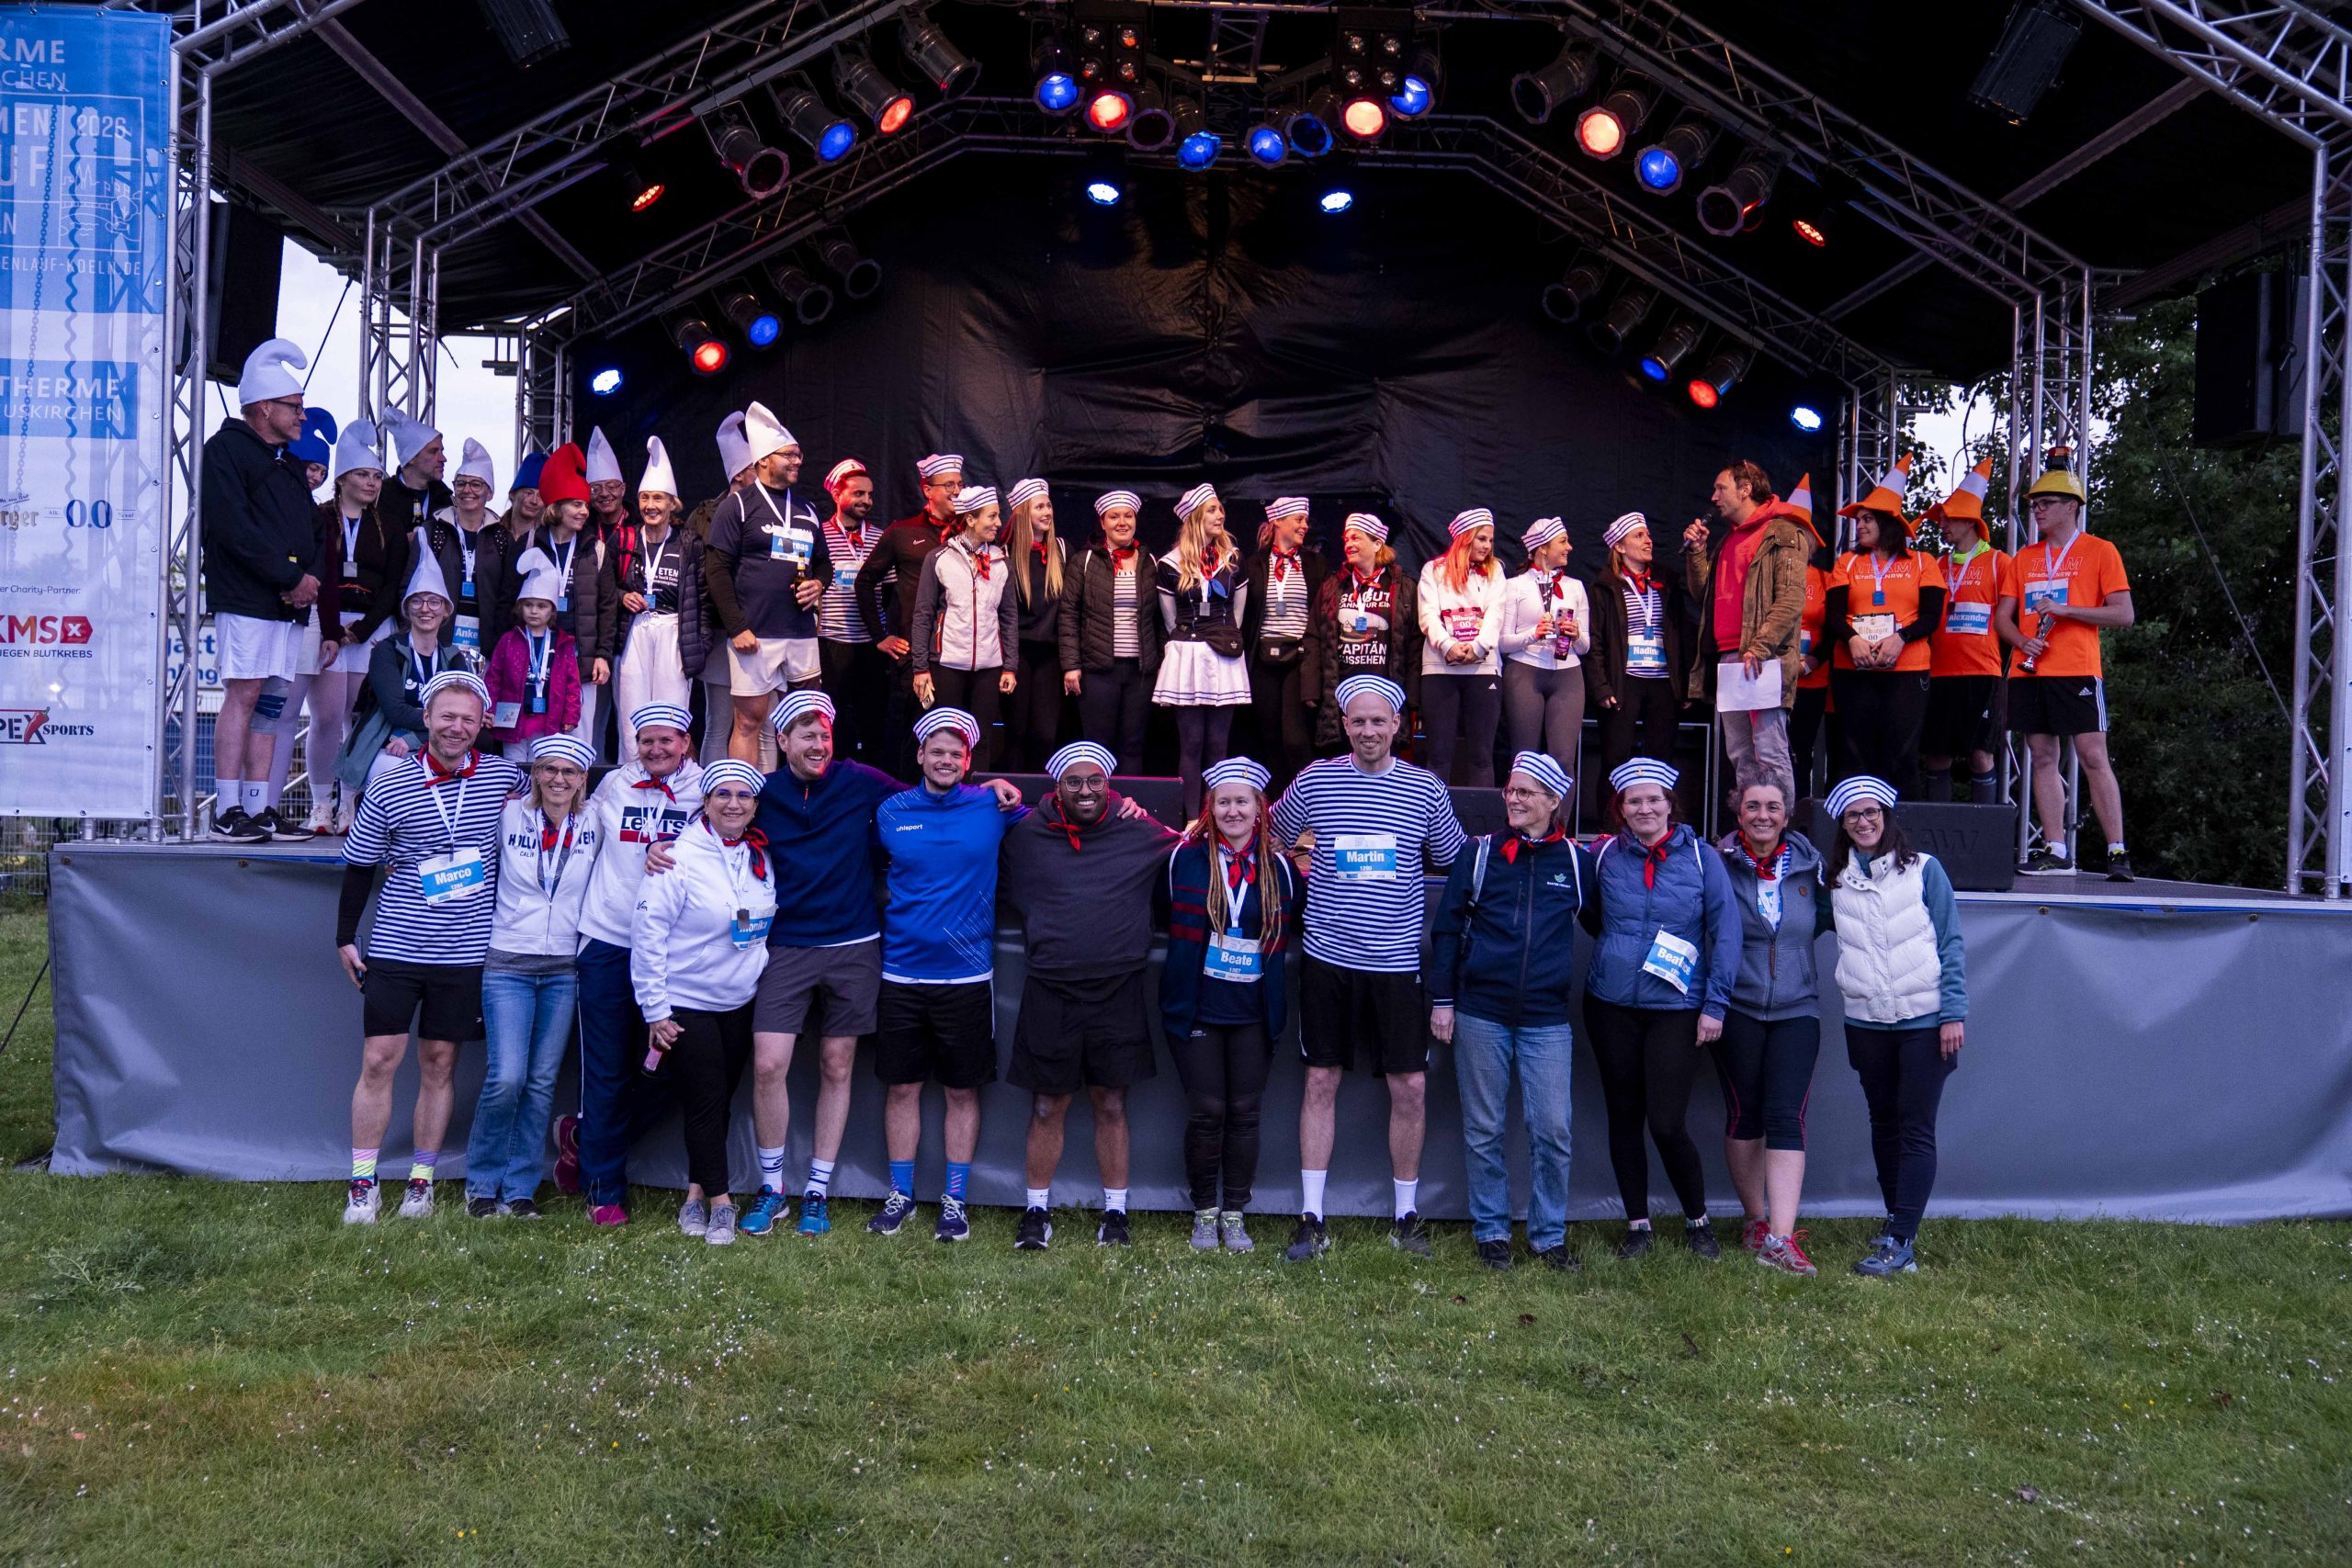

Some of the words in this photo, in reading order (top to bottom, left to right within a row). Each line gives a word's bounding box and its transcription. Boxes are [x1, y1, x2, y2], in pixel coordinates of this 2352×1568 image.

[0, 375, 120, 400] THERME
[65, 499, 113, 529] 0.0
[777, 538, 809, 551] Areas
[10, 584, 81, 595] Charity-Partner:
[1949, 613, 1988, 623] Alexander
[455, 627, 479, 639] Anke
[0, 649, 30, 658] EGEN
[33, 649, 93, 659] BLUTKREBS
[42, 724, 95, 736] SPORTS
[896, 824, 923, 832] uhlsport
[1346, 851, 1385, 863] Martin
[434, 867, 472, 885] Marco
[739, 919, 768, 933] onika
[1220, 951, 1253, 966] Beate
